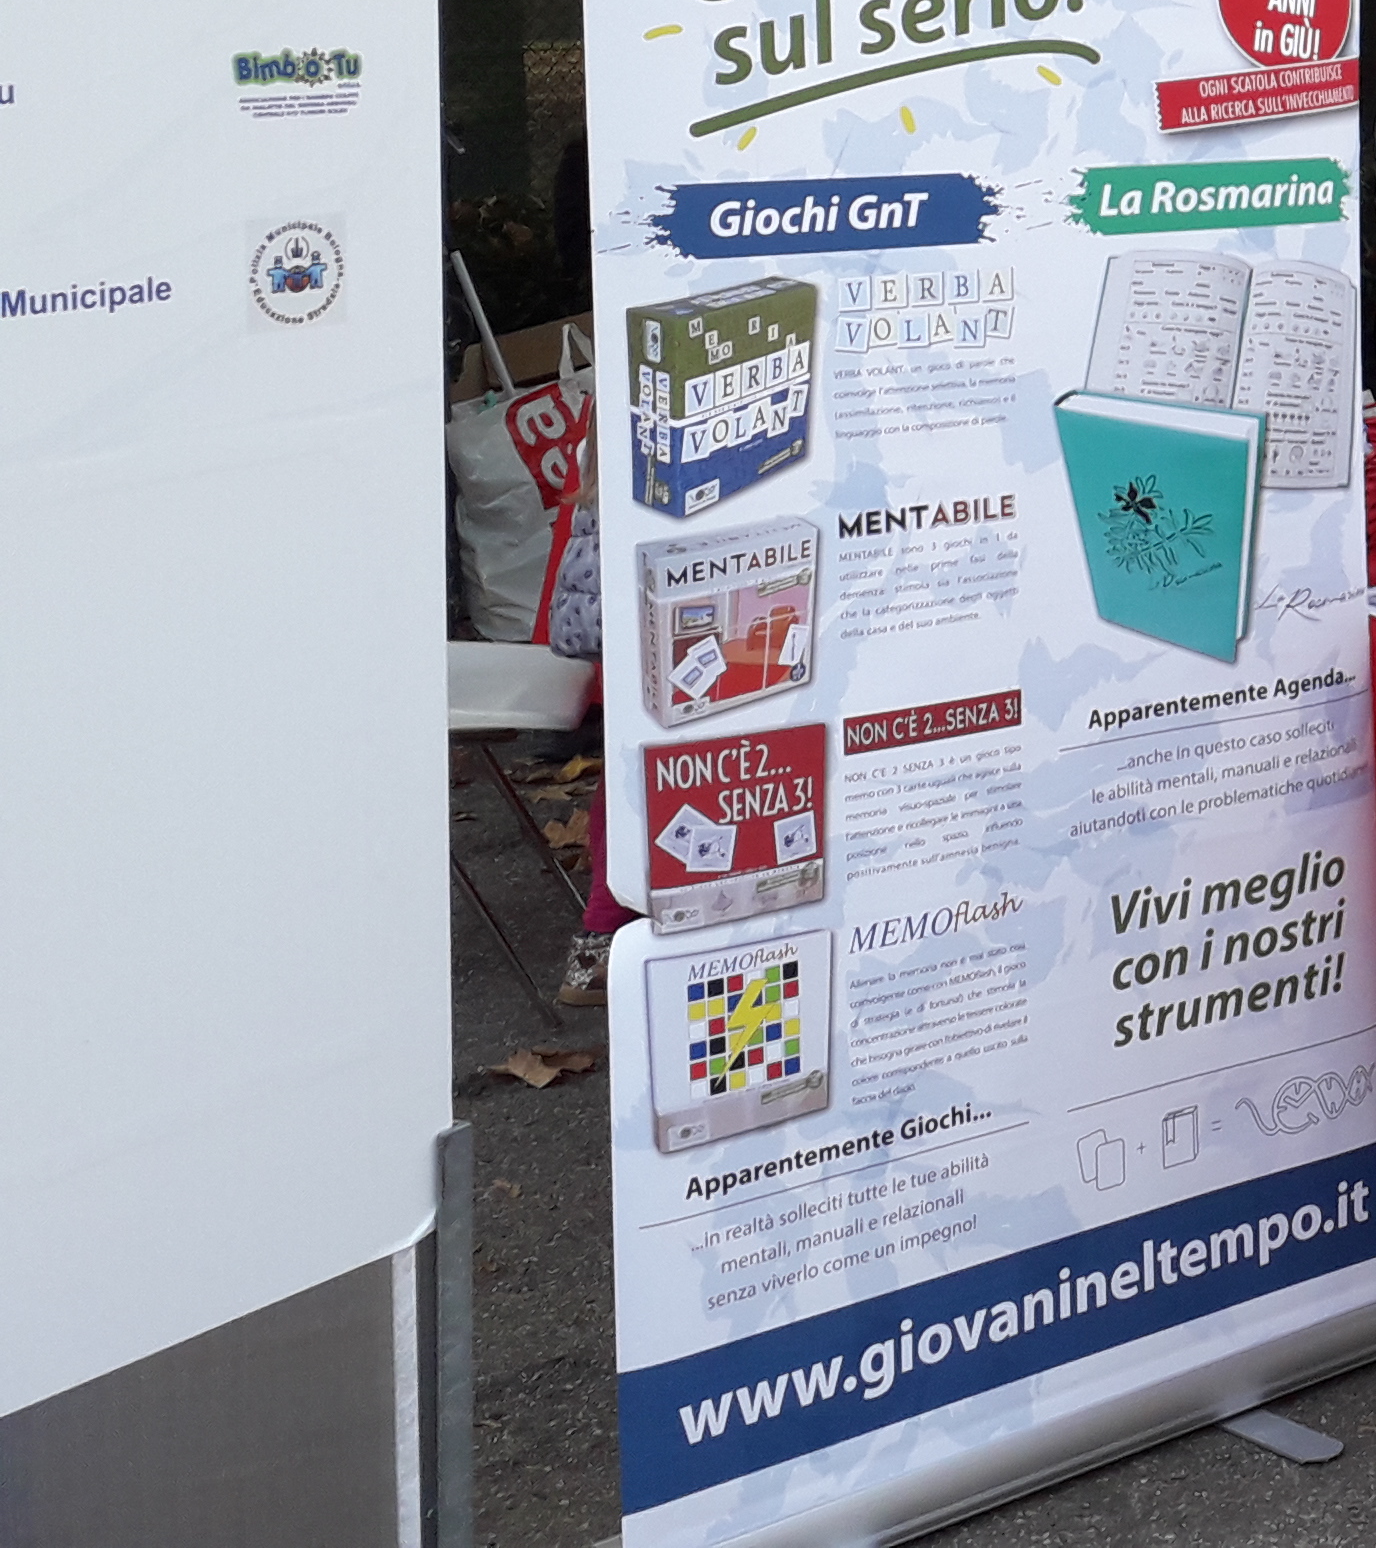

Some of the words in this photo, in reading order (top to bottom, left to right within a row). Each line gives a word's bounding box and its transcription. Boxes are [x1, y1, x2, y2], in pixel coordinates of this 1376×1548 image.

[1253, 20, 1274, 53] in
[1279, 18, 1320, 61] GIÙ!
[1200, 80, 1228, 99] OGNI
[1231, 72, 1278, 94] SCATOLA
[1279, 64, 1342, 88] CONTRIBUISCE
[1181, 106, 1208, 125] ALLA
[1210, 99, 1256, 122] RICERCA
[708, 195, 843, 240] Giochi
[849, 192, 930, 232] GnT
[1099, 179, 1143, 218] La
[1150, 173, 1336, 214] Rosmarina
[1, 276, 172, 314] Municipale
[845, 272, 1008, 307] VERBA
[844, 308, 1010, 347] VOLANT
[692, 349, 804, 407] VERBA
[690, 390, 802, 454] VOLANT
[839, 495, 1015, 539] MENTABILE
[667, 539, 811, 587] MENTABILE
[847, 719, 887, 747] NON
[893, 711, 917, 738] C'È
[1005, 697, 1018, 720] 3!
[1088, 684, 1268, 732] Apparentemente
[1273, 666, 1356, 700] Agenda...
[656, 753, 714, 792] NON
[717, 740, 751, 780] C'È
[755, 745, 792, 778] 2...
[1176, 745, 1190, 759] in
[1195, 737, 1245, 759] questo
[1250, 731, 1282, 747] caso
[718, 783, 787, 824] SENZA
[793, 777, 813, 812] 3!
[1092, 788, 1104, 803] le
[1108, 777, 1153, 801] abilità
[1157, 767, 1218, 791] mentali,
[1222, 756, 1280, 779] manuali
[1284, 756, 1292, 767] e
[1070, 807, 1145, 838] aiutandoti
[1149, 805, 1177, 821] con
[1181, 798, 1194, 814] le
[1198, 779, 1303, 814] problematiche
[1111, 877, 1192, 935] Vivi
[1202, 850, 1346, 912] meglio
[848, 892, 1023, 954] MEMOflash
[1112, 942, 1188, 991] con
[1201, 928, 1214, 970] i
[1224, 898, 1346, 966] nostri
[688, 944, 798, 982] MEMOflash
[1114, 952, 1346, 1048] strumenti!
[685, 1128, 895, 1201] Apparentemente
[900, 1102, 992, 1141] Giochi...
[725, 1214, 774, 1244] realtà
[779, 1192, 844, 1228] solleciti
[847, 1184, 888, 1208] tutte
[892, 1177, 907, 1196] le
[910, 1170, 937, 1190] tue
[940, 1152, 990, 1179] abilità
[720, 1243, 791, 1275] mentali,
[796, 1217, 864, 1253] manuali
[868, 1215, 878, 1230] e
[882, 1190, 965, 1228] relazionali
[707, 1284, 757, 1311] senza
[761, 1263, 820, 1294] viverlo
[823, 1249, 870, 1275] come
[874, 1242, 895, 1259] un
[678, 1179, 1370, 1448] www.giovanineltempo.it
